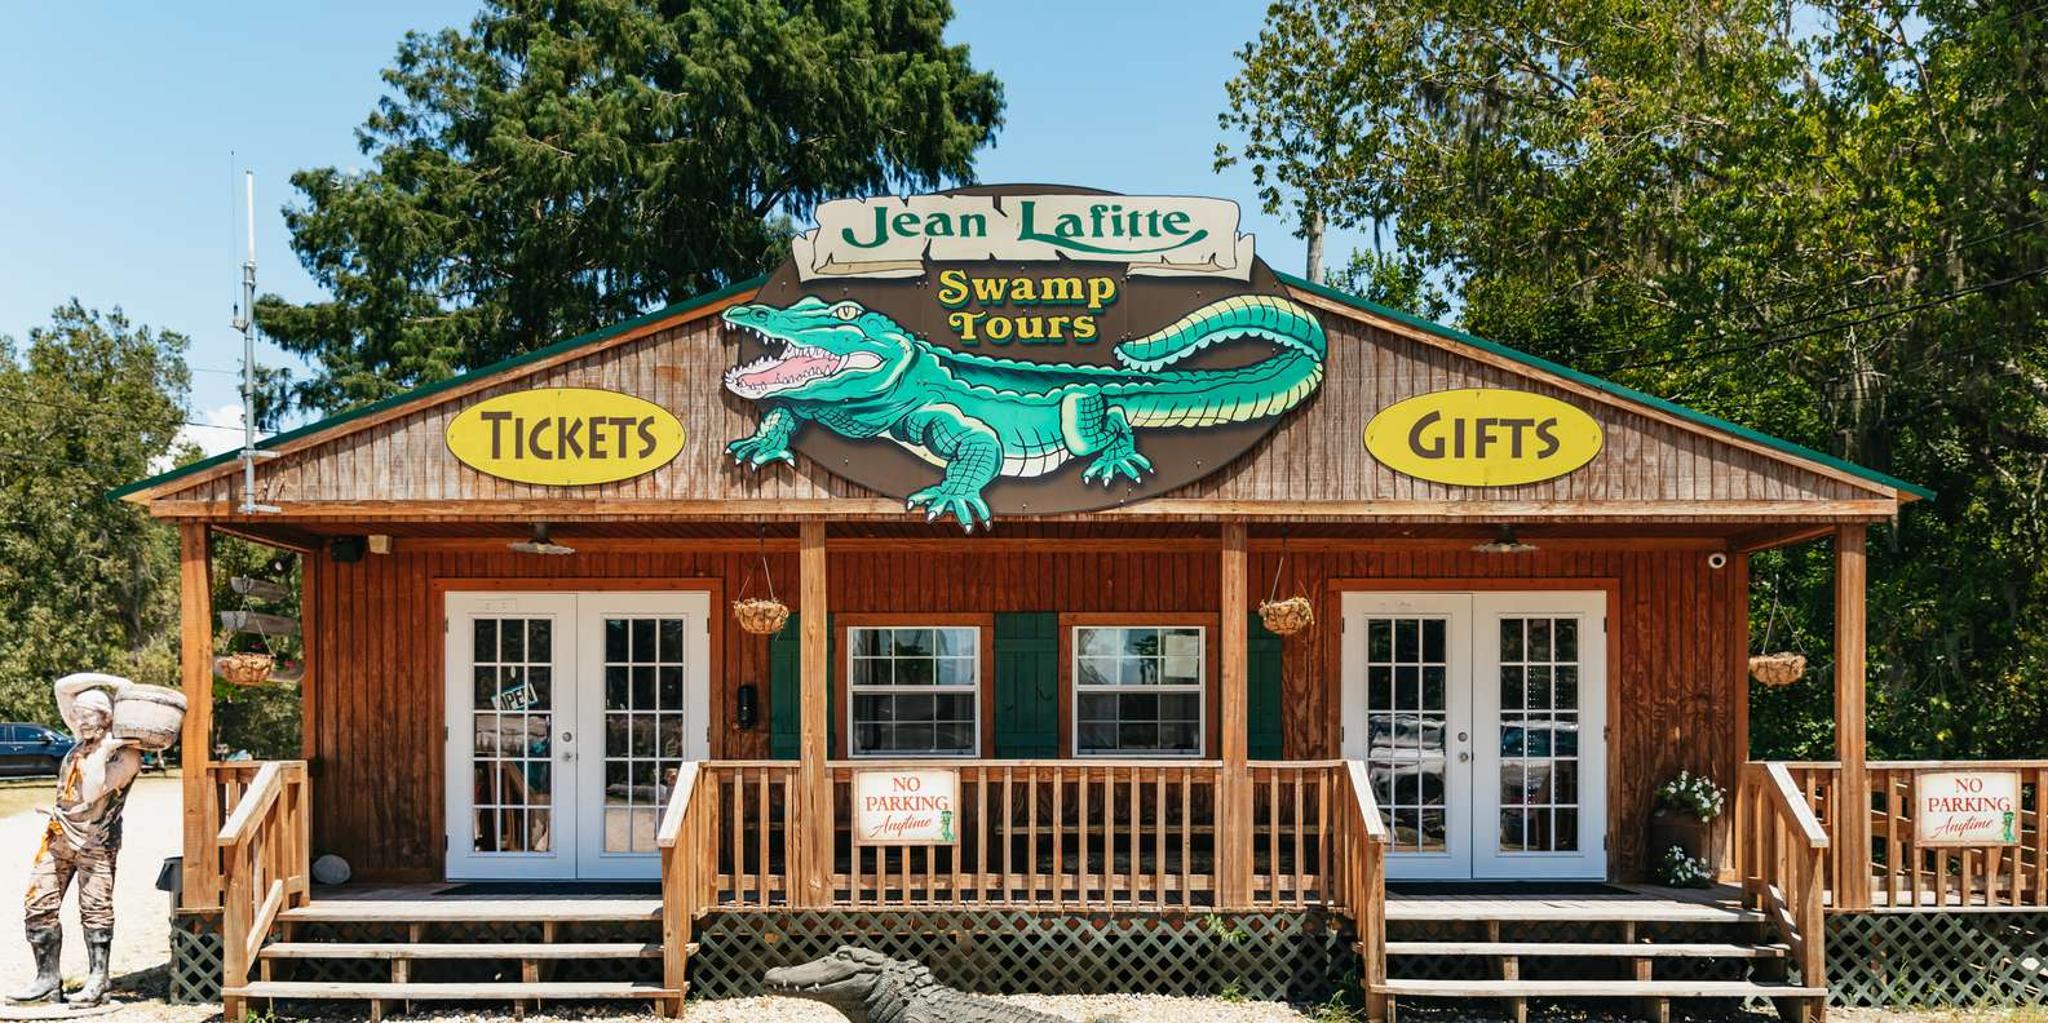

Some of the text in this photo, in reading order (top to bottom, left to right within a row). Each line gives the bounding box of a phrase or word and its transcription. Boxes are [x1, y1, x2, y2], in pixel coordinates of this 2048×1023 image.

[841, 200, 1209, 255] Jean Lafitte
[937, 268, 1118, 312] Swamp
[947, 310, 1099, 343] Tours
[480, 410, 658, 461] TICKETS
[1407, 409, 1561, 460] GIFTS
[892, 776, 921, 793] NO
[1954, 777, 1983, 793] NO
[865, 795, 949, 812] PARKING
[1927, 796, 2011, 813] PARKING
[869, 814, 932, 838] Anytime
[1930, 815, 1993, 839] Anytime
